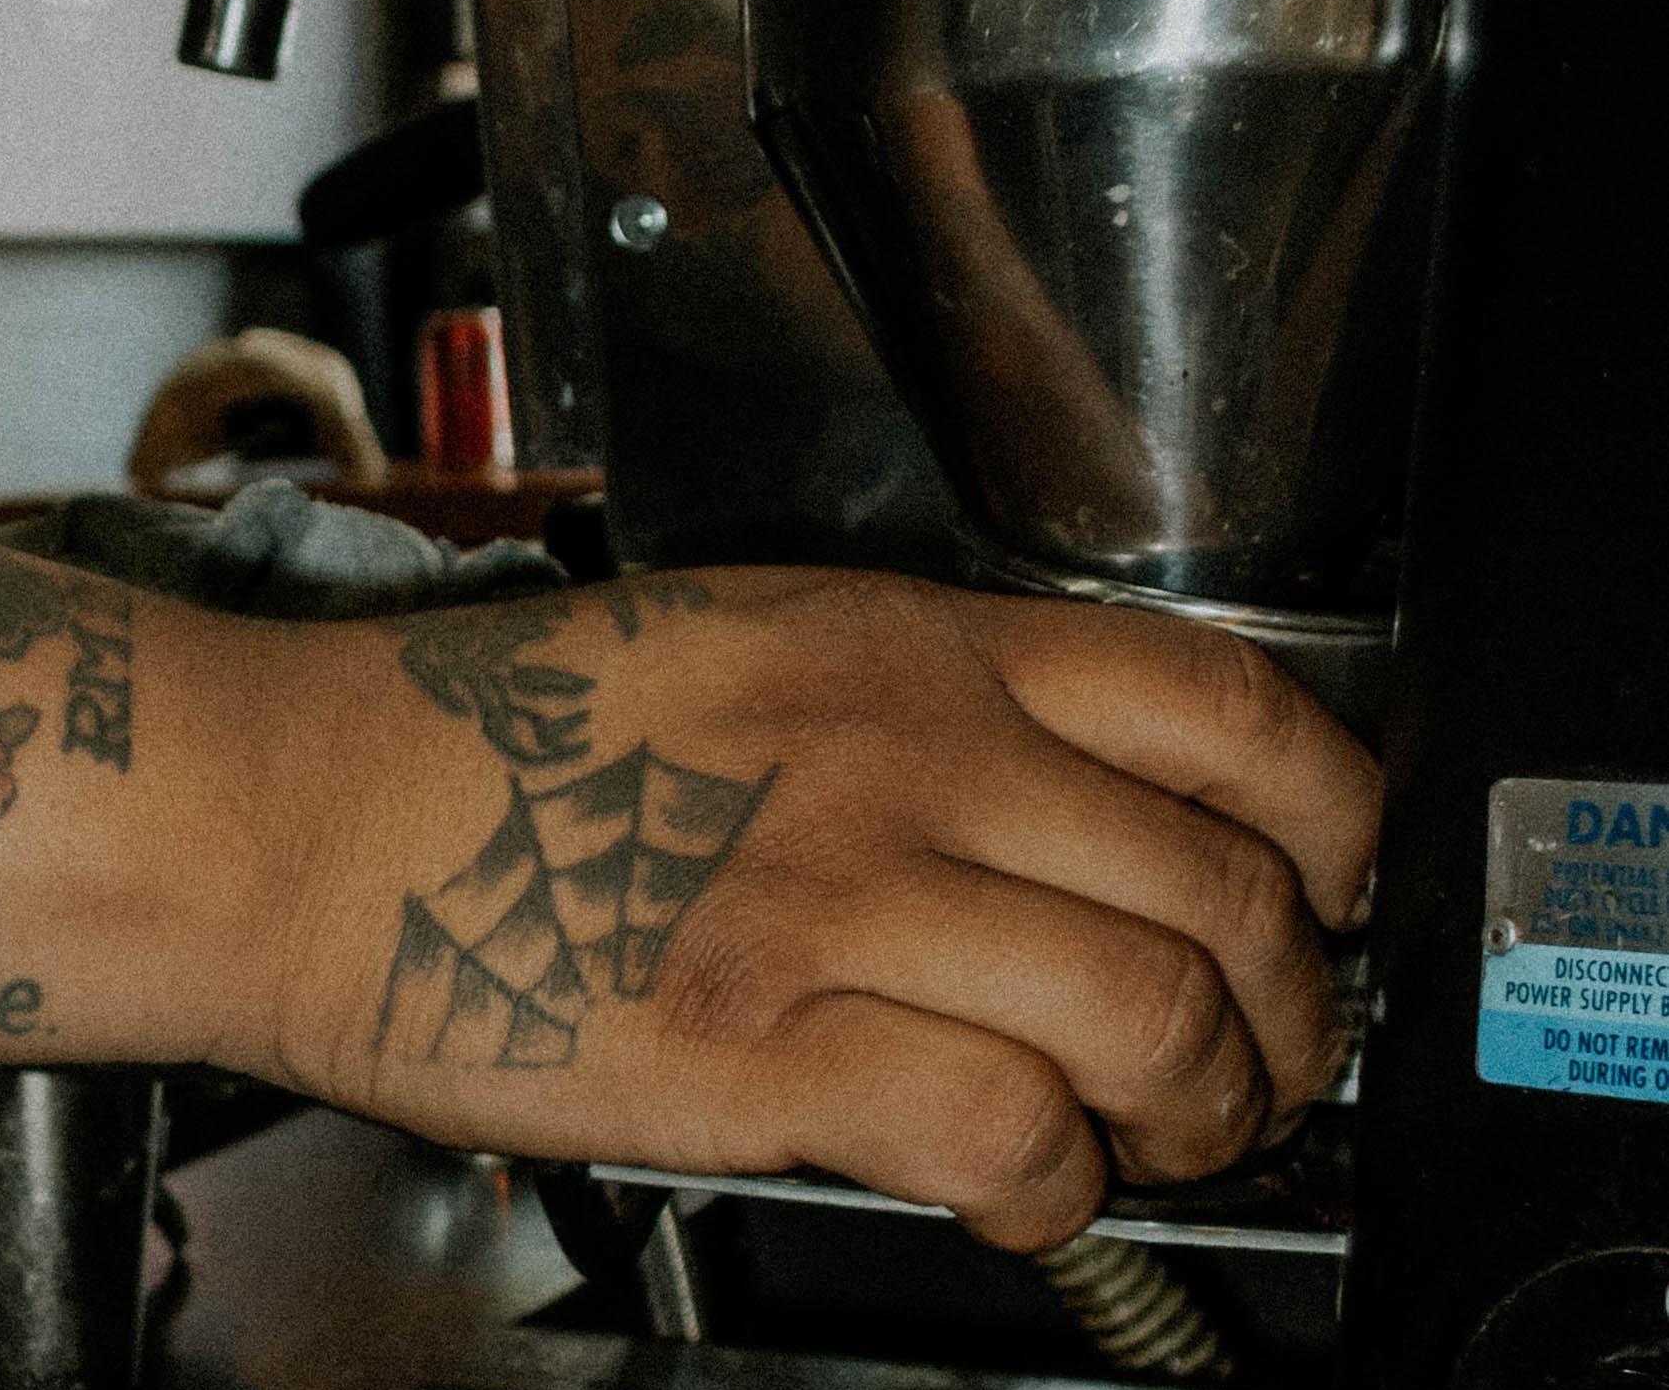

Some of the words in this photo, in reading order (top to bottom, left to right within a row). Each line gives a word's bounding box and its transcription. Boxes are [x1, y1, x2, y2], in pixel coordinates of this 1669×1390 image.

[1505, 981, 1573, 1009] POWER
[1579, 988, 1653, 1016] SUPPLY
[1543, 1027, 1571, 1052] DO
[1577, 1030, 1620, 1057] NOT
[1567, 1058, 1647, 1089] DURING
